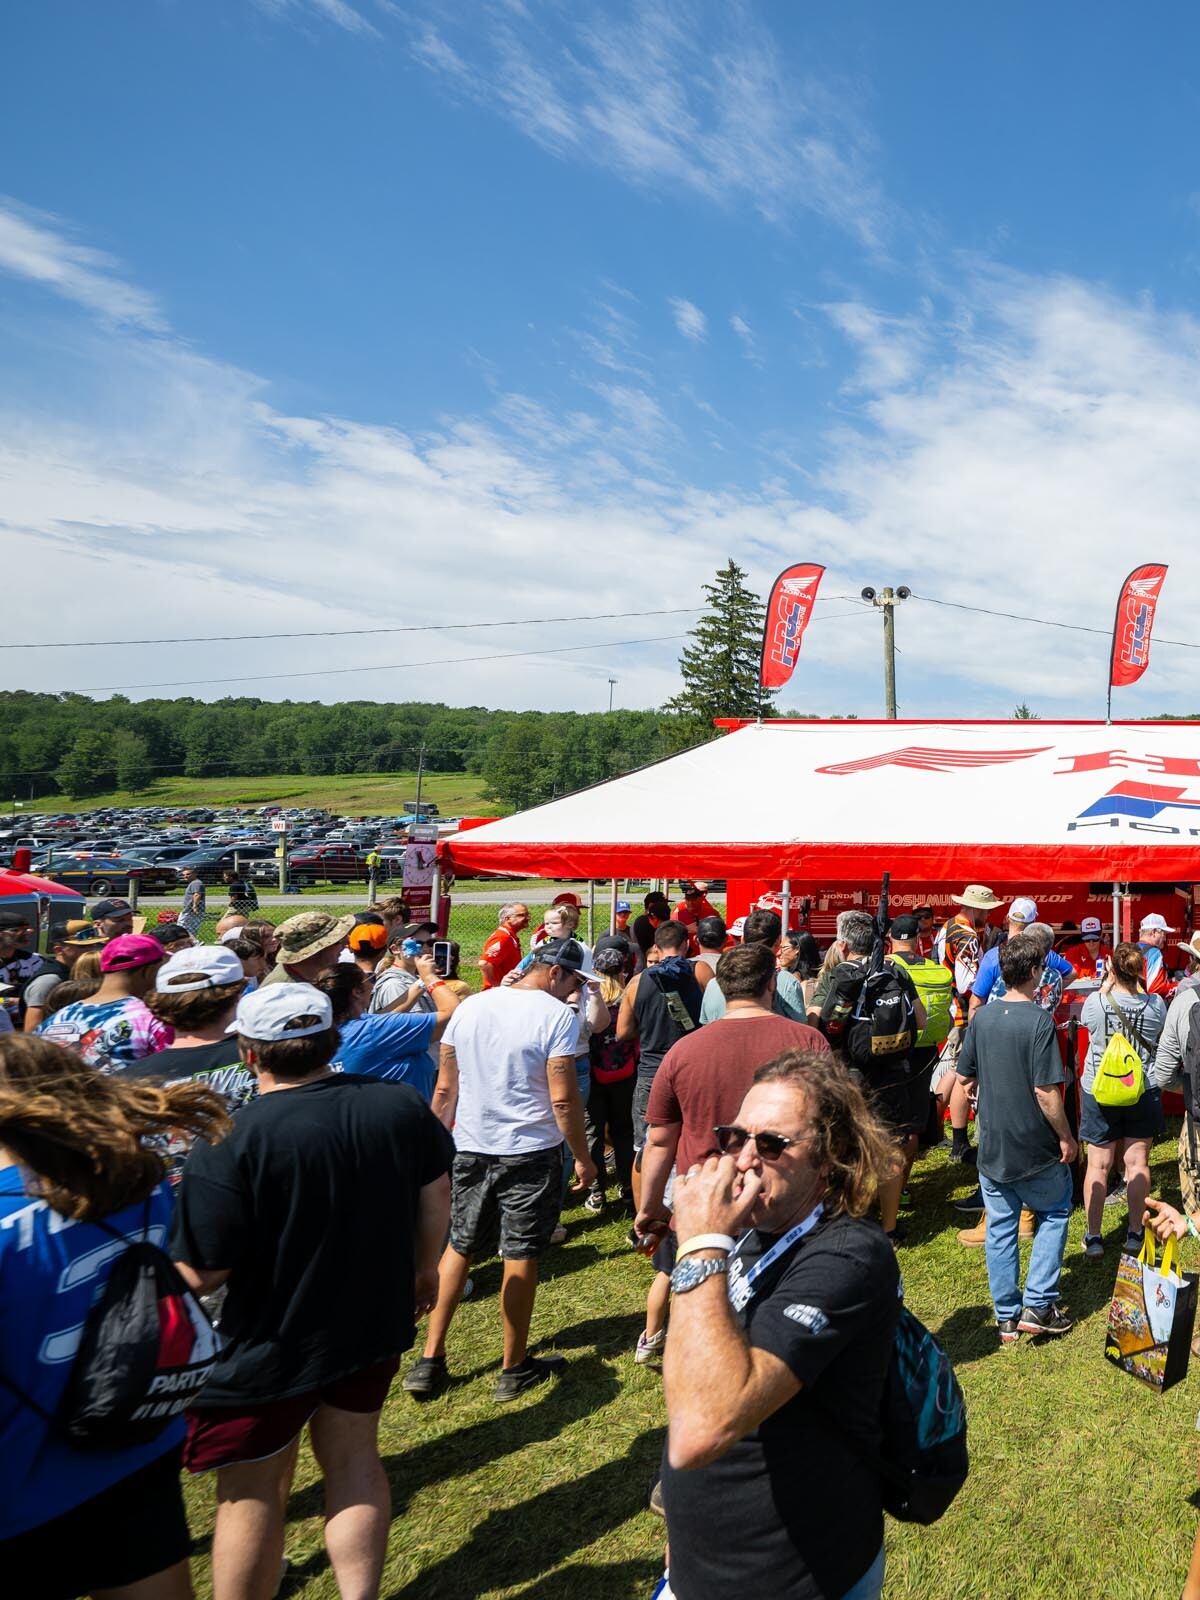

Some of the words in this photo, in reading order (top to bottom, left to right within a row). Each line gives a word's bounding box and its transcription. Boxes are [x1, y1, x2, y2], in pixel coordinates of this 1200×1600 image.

[779, 587, 812, 600] HONDA
[1127, 589, 1157, 600] HONDA
[771, 596, 802, 668] HRC
[1121, 597, 1149, 667] HRC
[886, 894, 959, 906] OSHIMU
[1002, 894, 1073, 903] DNLOP
